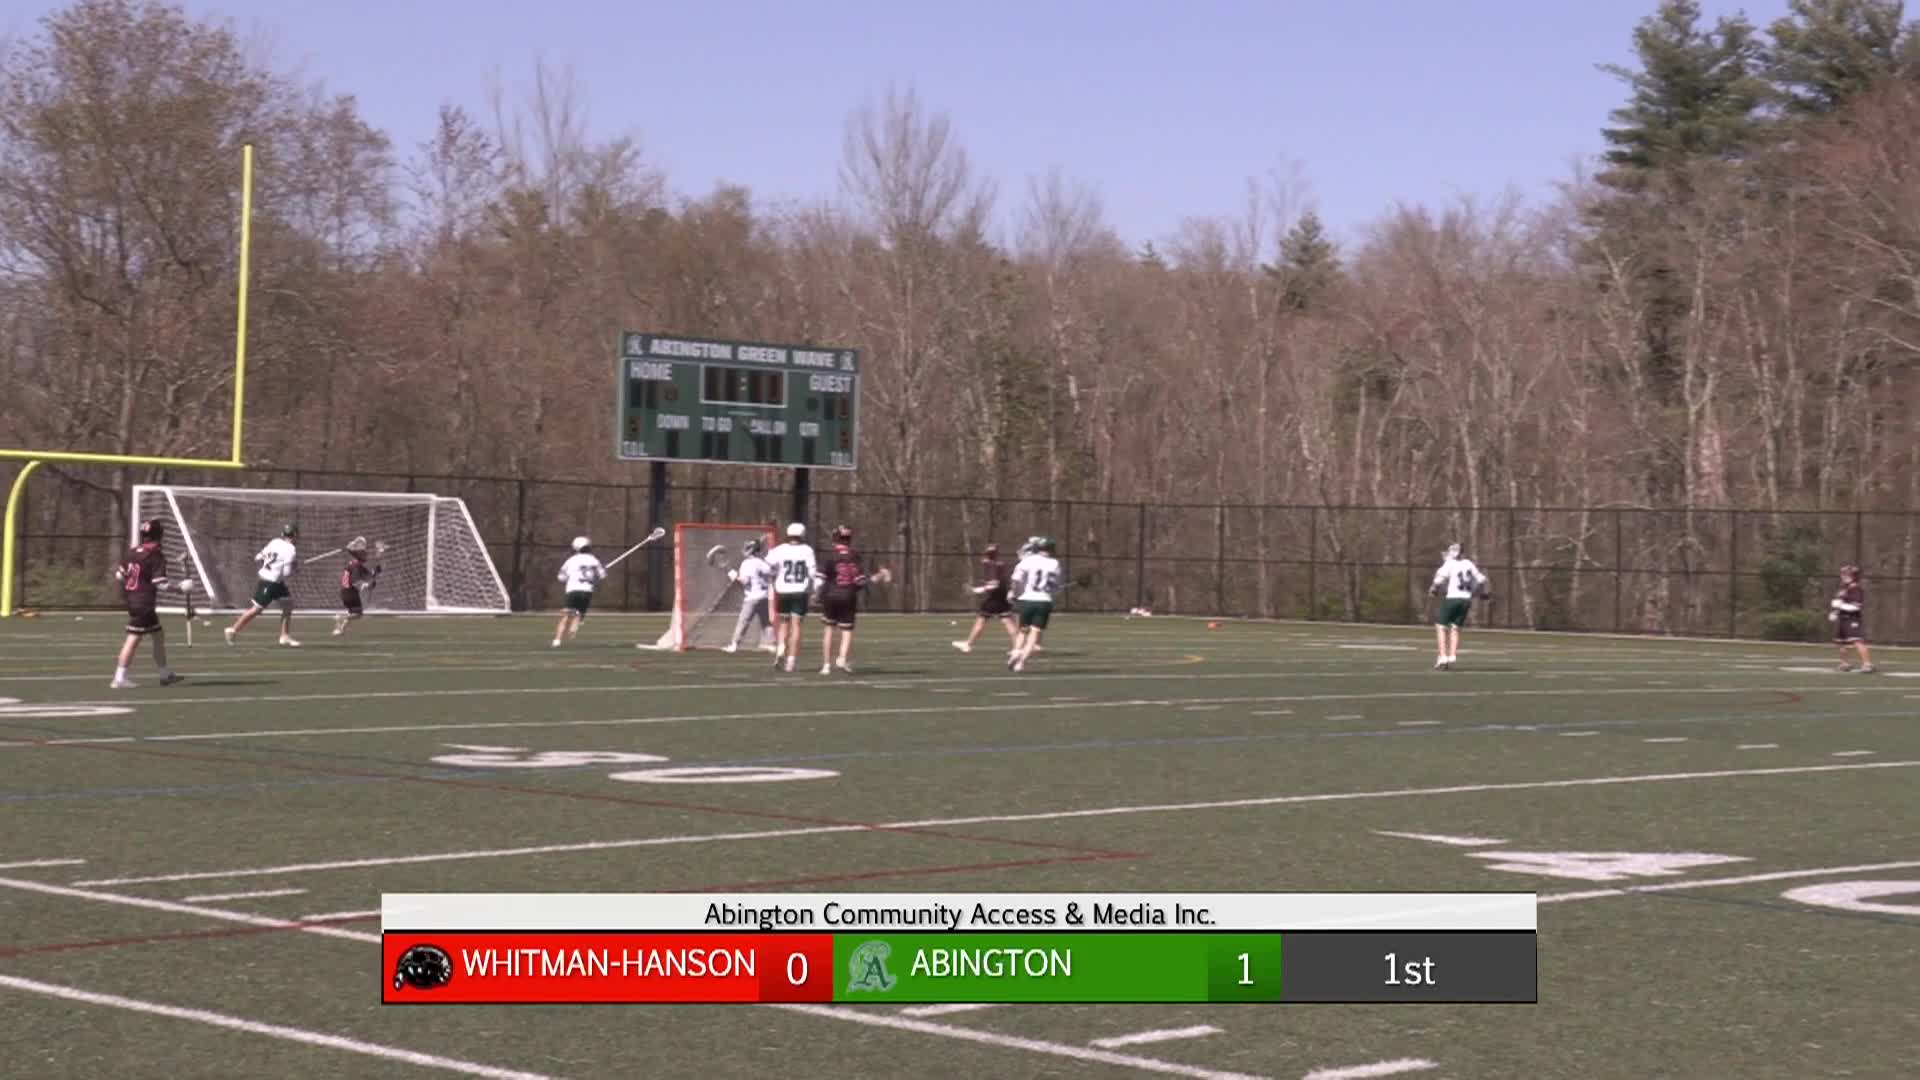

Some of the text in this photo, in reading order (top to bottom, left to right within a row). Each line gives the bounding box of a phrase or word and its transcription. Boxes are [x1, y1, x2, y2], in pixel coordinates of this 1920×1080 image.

[649, 338, 732, 360] ABINGTON
[737, 346, 787, 364] GREEN
[792, 350, 835, 368] WAVE
[630, 361, 673, 381] HOME
[809, 374, 852, 393] GUEST
[657, 413, 690, 430] DOWN
[783, 559, 809, 583] 20
